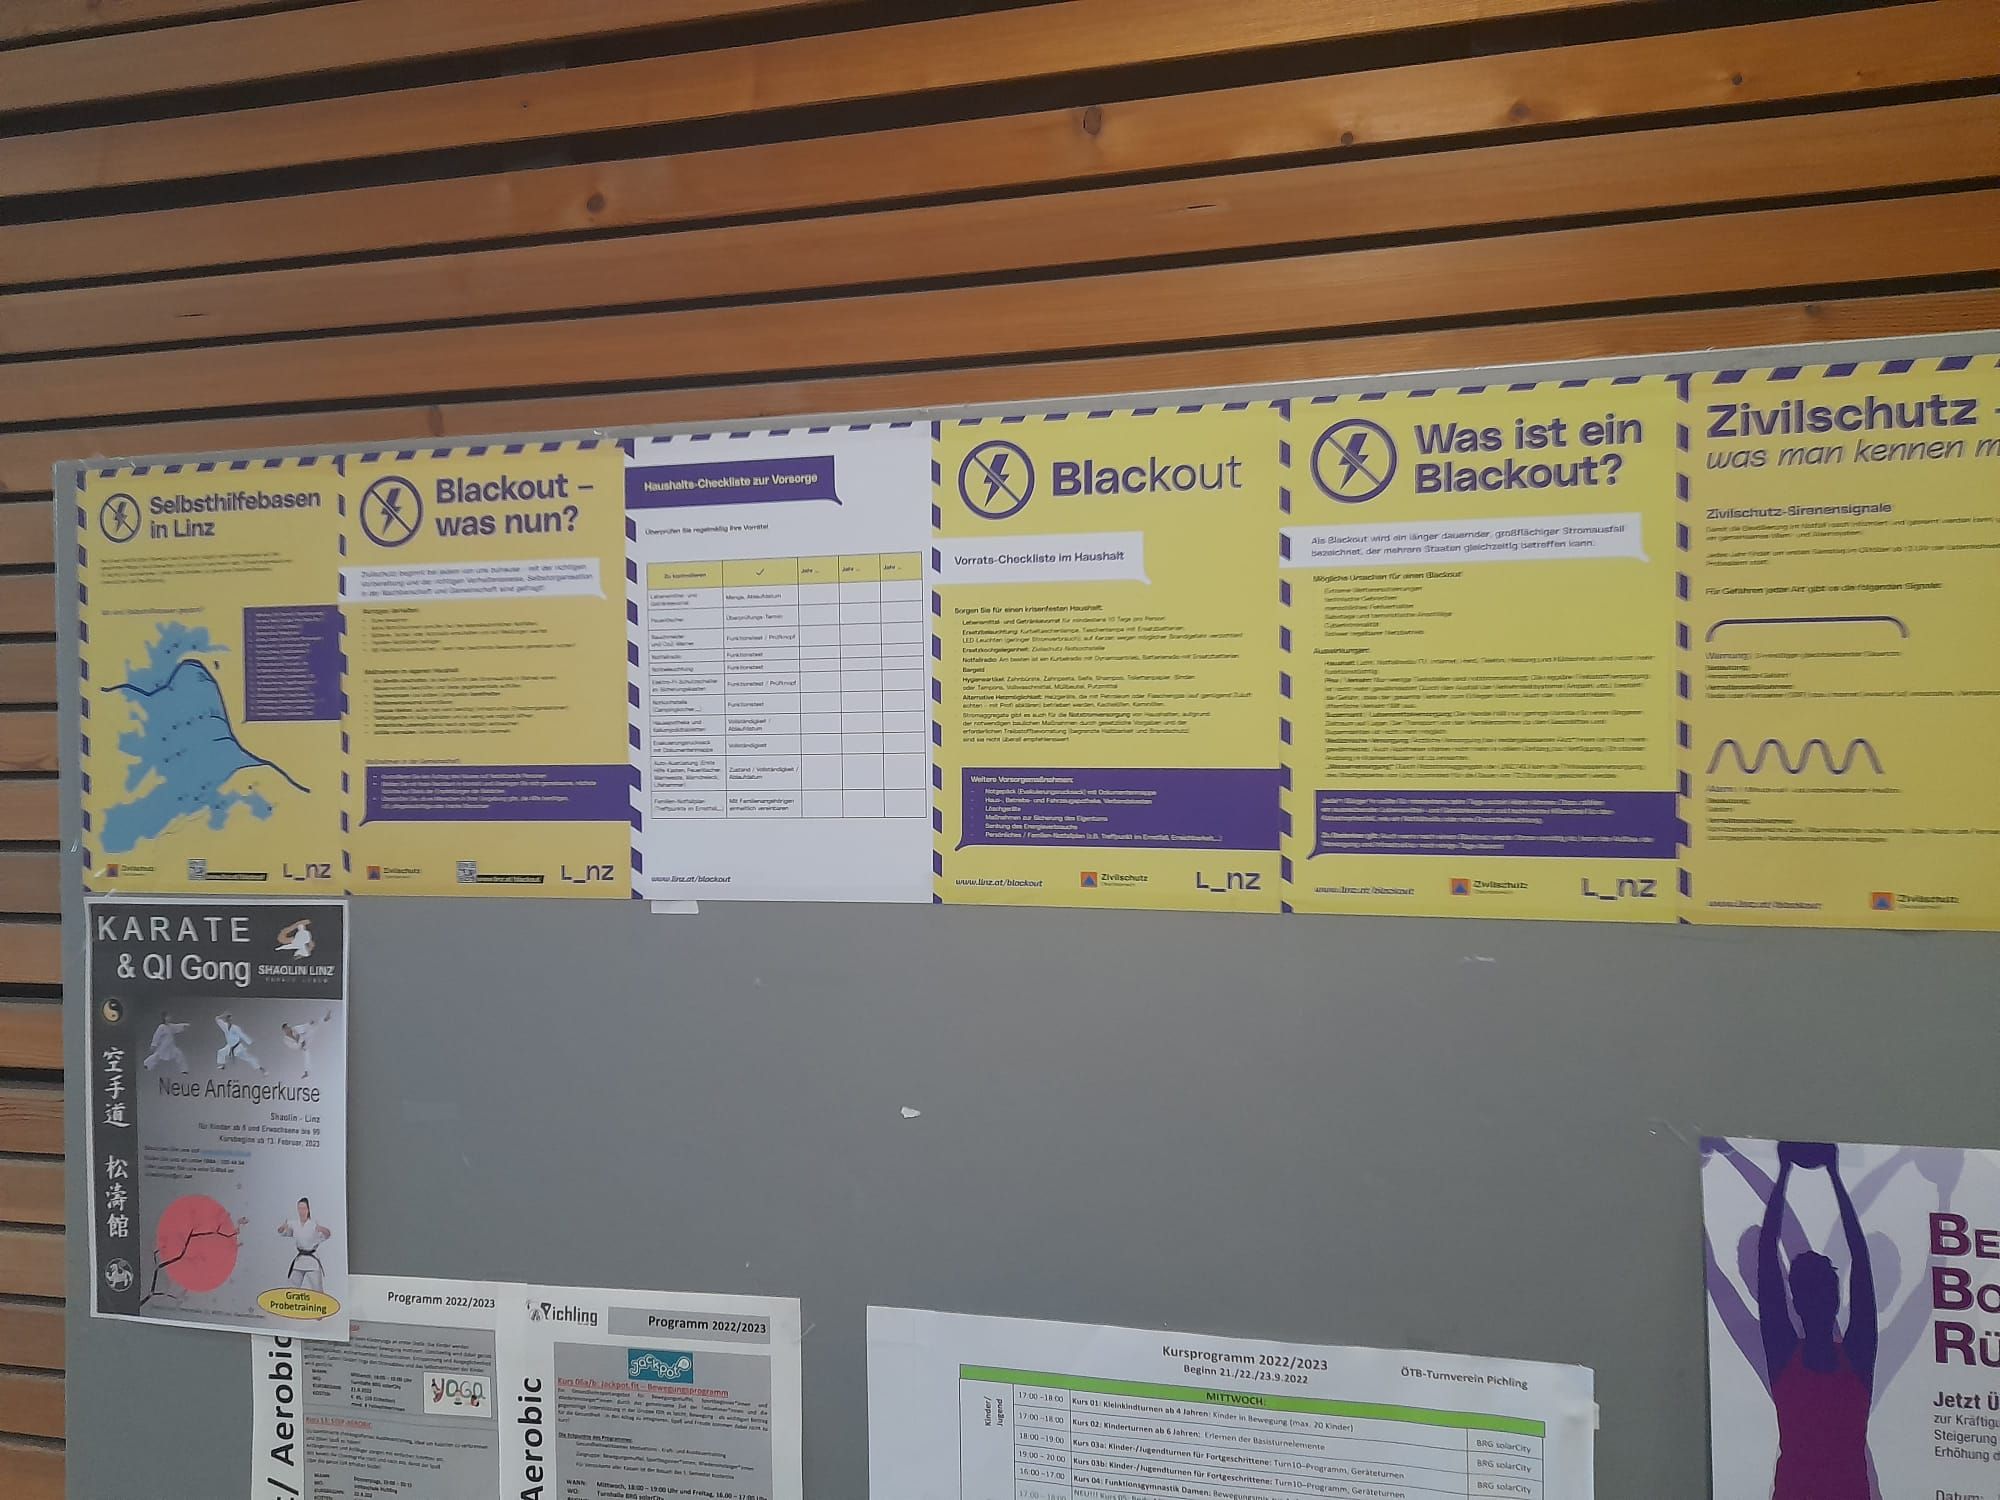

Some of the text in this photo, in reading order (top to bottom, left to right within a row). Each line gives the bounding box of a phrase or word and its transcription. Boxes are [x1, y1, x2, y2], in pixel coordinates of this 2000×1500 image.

[1706, 394, 1978, 438] Zivilschutz
[1413, 412, 1643, 455] Was ist ein
[1706, 448, 1767, 470] was
[1777, 445, 1843, 467] man
[1853, 438, 1964, 463] kennen
[644, 473, 818, 492] Haushalts-Checkliste zur Vorsorge
[1052, 456, 1242, 497] Blackout
[1414, 453, 1623, 494] Blackout?
[435, 473, 569, 504] Blackout
[149, 490, 321, 515] Selbsthilfebasen
[1706, 502, 1892, 520] Zivilschutz-Sirenensignale
[150, 520, 215, 539] in Linz
[435, 505, 579, 537] was nun?
[645, 524, 742, 537] Überprüfen Sie regelmäßig Ihre
[1311, 536, 1326, 545] Als
[1328, 534, 1368, 544] Blackout
[1370, 533, 1390, 542] wird
[1393, 533, 1407, 541] ein
[1409, 531, 1438, 542] länger
[1495, 527, 1560, 539] großflächiger
[1563, 524, 1625, 536] Stromausfall
[1366, 547, 1381, 555] der
[1383, 546, 1422, 555] mehrere
[1424, 544, 1462, 554] Staaten
[1463, 541, 1518, 553] gleichzeitig
[1520, 540, 1567, 550] betreffen
[954, 550, 1125, 566] Vorrats-Checkliste im Haushalt
[1313, 573, 1348, 583] Mögliche
[1389, 572, 1401, 580] für
[1705, 587, 1722, 595] Für
[1723, 586, 1763, 595] Gefahren
[1791, 585, 1806, 593] Art
[1807, 585, 1825, 594] gibt
[1856, 583, 1902, 592] folgenden
[954, 607, 978, 615] Sorgen
[1025, 605, 1068, 613] krisenfesten
[970, 776, 997, 784] Weitere
[955, 877, 1043, 887] www.linz.at/blackout
[1101, 873, 1149, 882] Zivilschutz
[1473, 880, 1529, 890] Zivilschutz
[98, 916, 250, 943] KARATE
[117, 953, 136, 979] &
[180, 954, 250, 987] Gong
[258, 965, 336, 976] SHAOLIN LINZ
[159, 1077, 321, 1104] Neue Anfängerkurse
[270, 1112, 320, 1123] Shaolin Linz
[285, 1291, 311, 1302] Gratis
[387, 1291, 495, 1309] Programm 2022/2023
[270, 1301, 327, 1314] Probetraining
[648, 1315, 766, 1334] Programm 2022/2023
[1162, 1345, 1328, 1371] Kursprogramm 2022/2023
[1184, 1364, 1308, 1384] Beginn 21./22./23.9.2022
[1401, 1365, 1528, 1391] ÖTB-Turnverein Pichling
[268, 1336, 295, 1466] Aerobic
[1933, 1391, 1981, 1410] Jetzt
[984, 1396, 992, 1426] Kinder/
[1072, 1398, 1088, 1406] Kurs
[1103, 1400, 1163, 1412] Kleinkindturnen
[1212, 1412, 1237, 1421] Kinder
[1248, 1415, 1287, 1427] Bewegung
[1314, 1421, 1324, 1429] 20
[1325, 1422, 1354, 1433] Kinder)
[1933, 1414, 1952, 1425] zur
[1072, 1419, 1088, 1427] Kurs
[1104, 1422, 1153, 1433] Kinderturnen
[1205, 1432, 1236, 1442] Erlernen
[1238, 1435, 1251, 1443] der
[1253, 1437, 1325, 1451] Basisturnelemente
[1934, 1429, 1998, 1447] Steigerung
[1476, 1439, 1531, 1454] BRG solarCity
[1935, 1446, 1990, 1463] Erhöhung
[1073, 1439, 1089, 1447] Kurs
[1108, 1442, 1191, 1458] Kinder-/Jugendturnen
[1193, 1450, 1204, 1459] für
[1206, 1452, 1272, 1467] Fortgeschrittene:
[1351, 1467, 1405, 1479] Geräteturnen
[1477, 1459, 1531, 1473] BRG solarCity
[1073, 1457, 1089, 1466] Kurs
[1109, 1460, 1192, 1476] Kinder-/Jugendturnen
[1193, 1468, 1204, 1477] für
[1206, 1471, 1272, 1486] Fortgeschrittene:
[1352, 1487, 1405, 1499] Geräteturnen
[1073, 1475, 1090, 1483] Kurs
[1104, 1478, 1179, 1494] Funktionsgymnastik
[1182, 1486, 1211, 1497] Damen:
[1477, 1481, 1531, 1495] BRG solarCity
